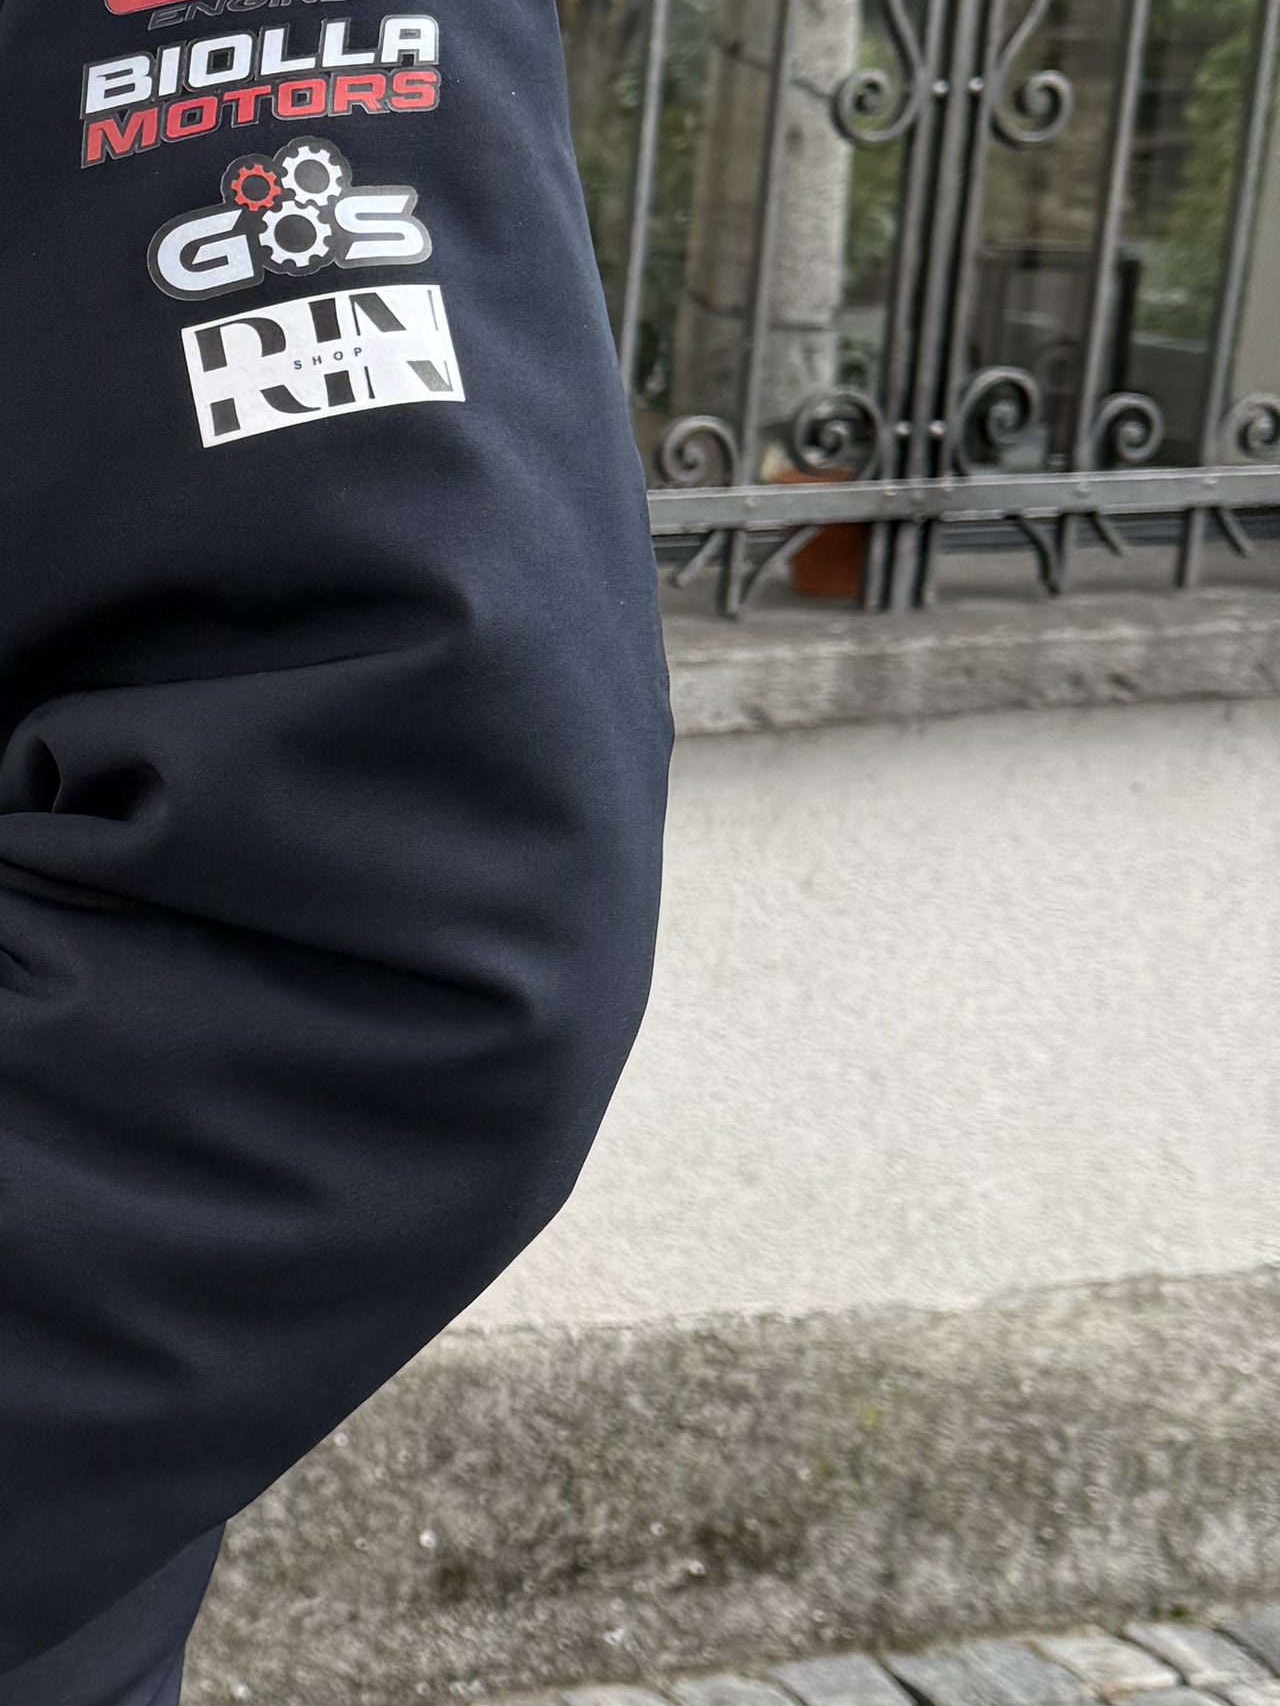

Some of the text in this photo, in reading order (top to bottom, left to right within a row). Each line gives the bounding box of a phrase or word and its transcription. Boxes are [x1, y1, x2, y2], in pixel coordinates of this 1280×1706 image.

[84, 17, 438, 115] BIOLLA
[84, 70, 438, 163] MOTORS
[293, 347, 363, 370] SHOP
